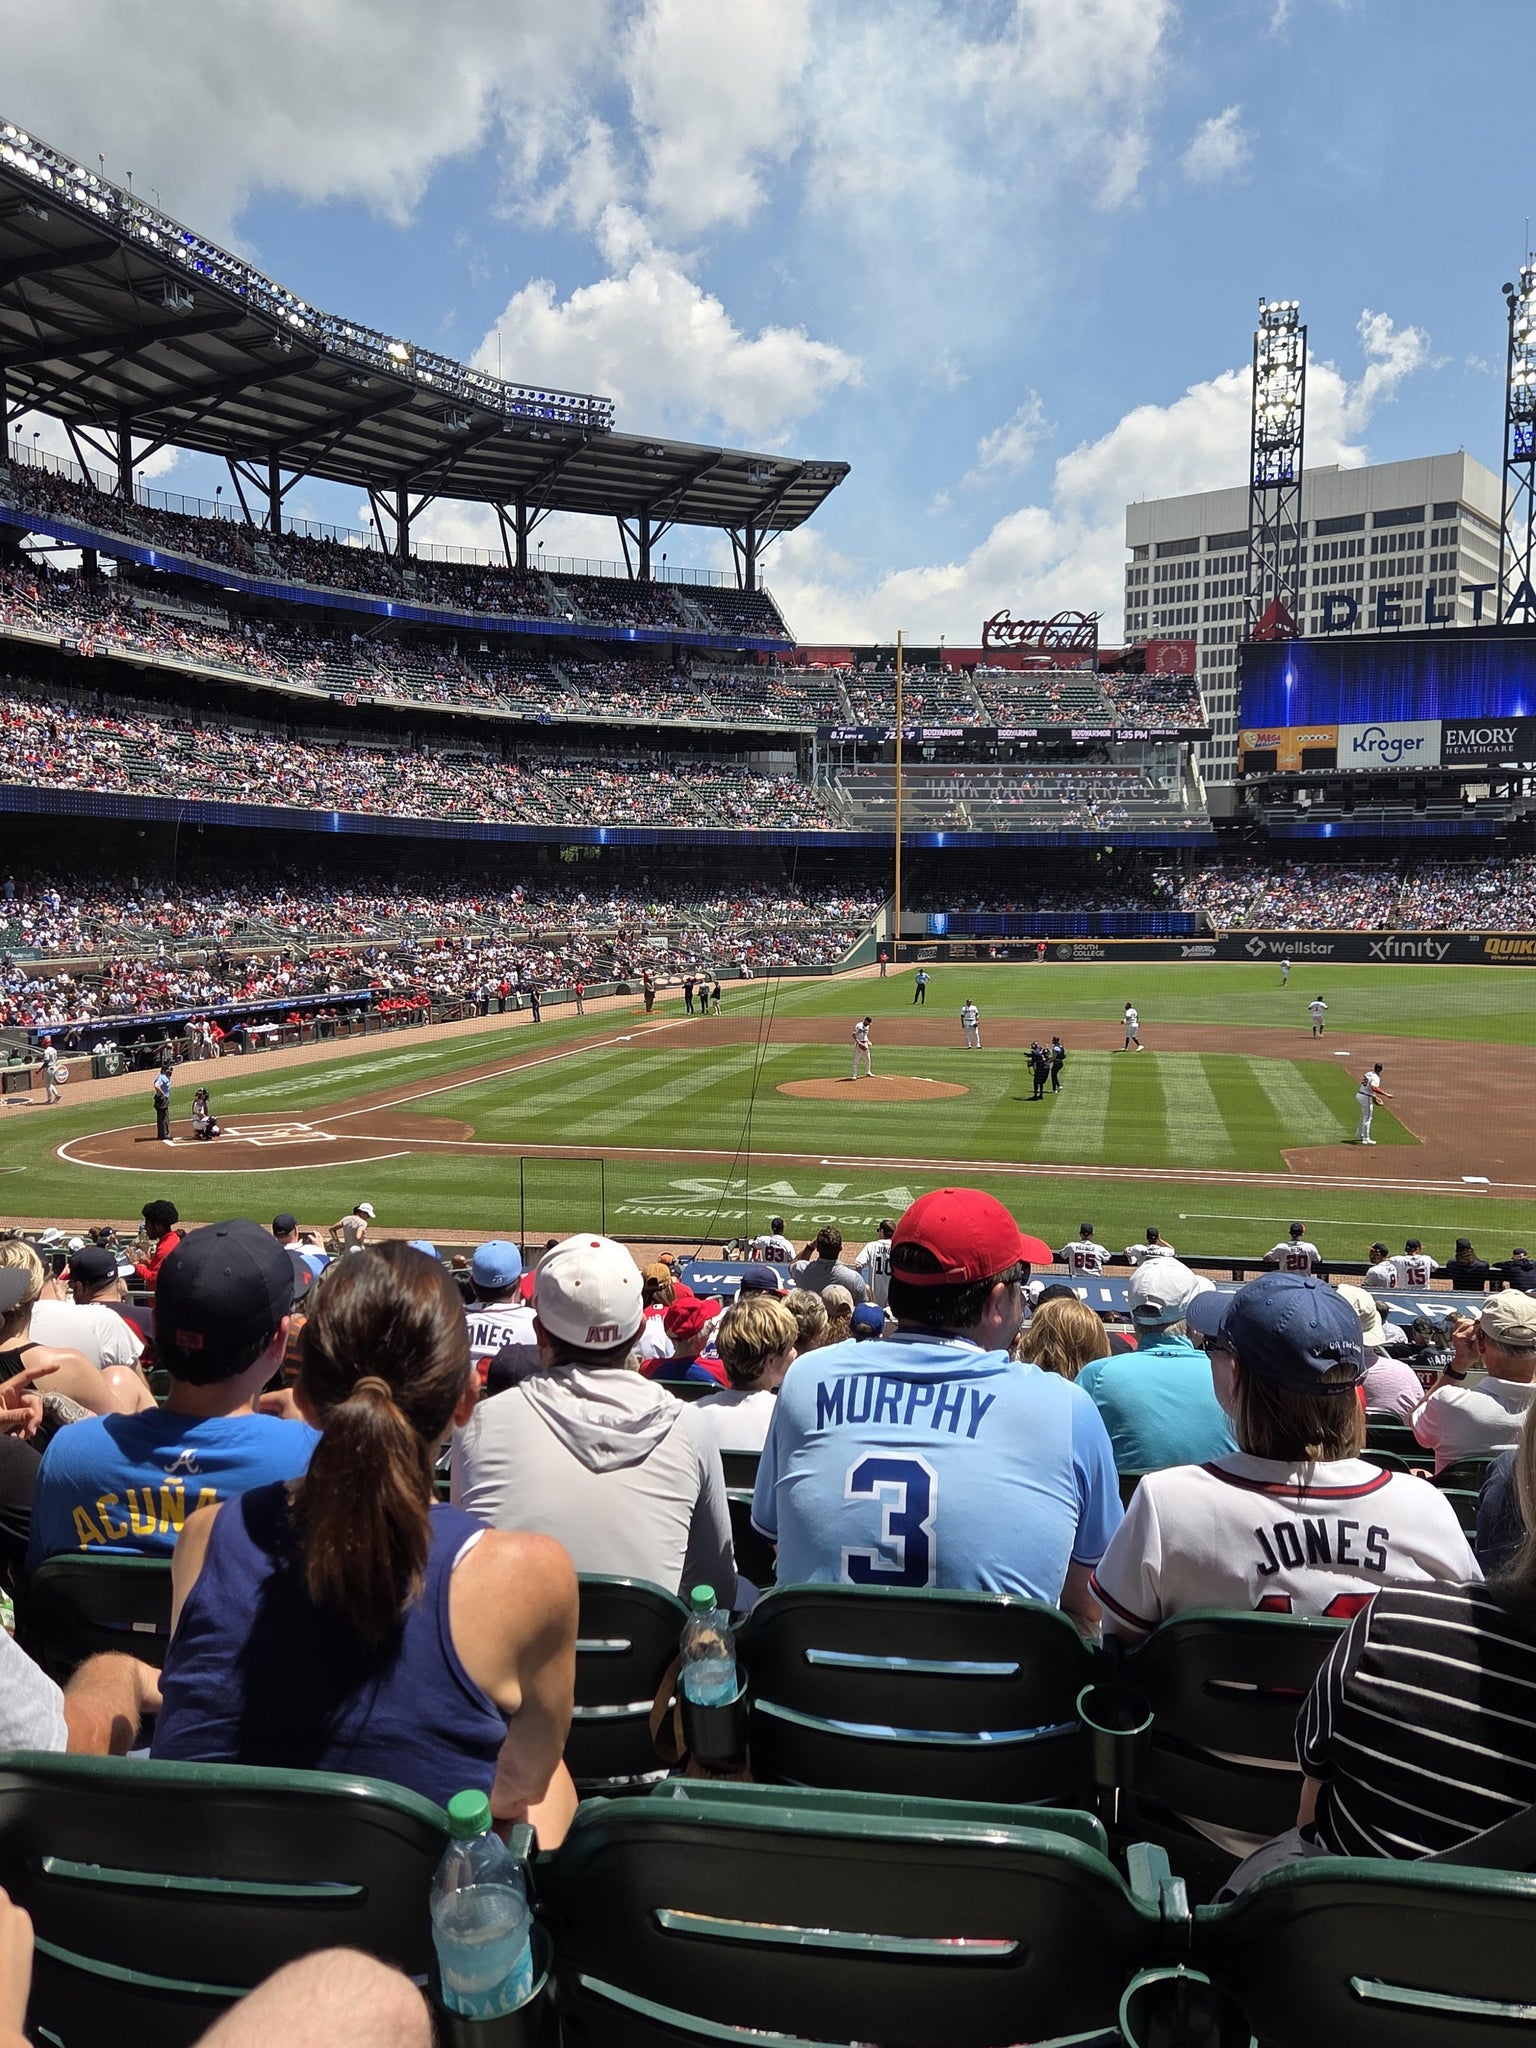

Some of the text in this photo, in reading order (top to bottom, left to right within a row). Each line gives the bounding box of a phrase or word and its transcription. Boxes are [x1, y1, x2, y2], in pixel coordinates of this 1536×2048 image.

[1324, 581, 1536, 631] DELTA
[77, 638, 94, 657] 44
[343, 692, 358, 706] 47
[998, 729, 1037, 737] BODYARMOR
[1116, 730, 1148, 739] 1:35 PM
[1445, 728, 1517, 746] EMORY
[1353, 727, 1424, 763] Kroger
[1445, 745, 1514, 754] HEALTHCARE
[925, 780, 1151, 798] HANK AARON TERRACE
[1268, 941, 1335, 954] Wellstar
[1368, 935, 1451, 961] xfinity
[612, 1205, 893, 1226] FREIGHT LOGIS
[764, 1245, 785, 1262] 83
[1074, 1252, 1096, 1270] 85
[1286, 1254, 1308, 1271] 20
[1406, 1268, 1426, 1285] 15
[469, 1323, 514, 1347] NES
[585, 1325, 622, 1343] ATL
[1427, 1354, 1456, 1367] HARR
[816, 1375, 997, 1440] MURPHY
[841, 1450, 939, 1588] 3
[1254, 1518, 1390, 1577] JONES
